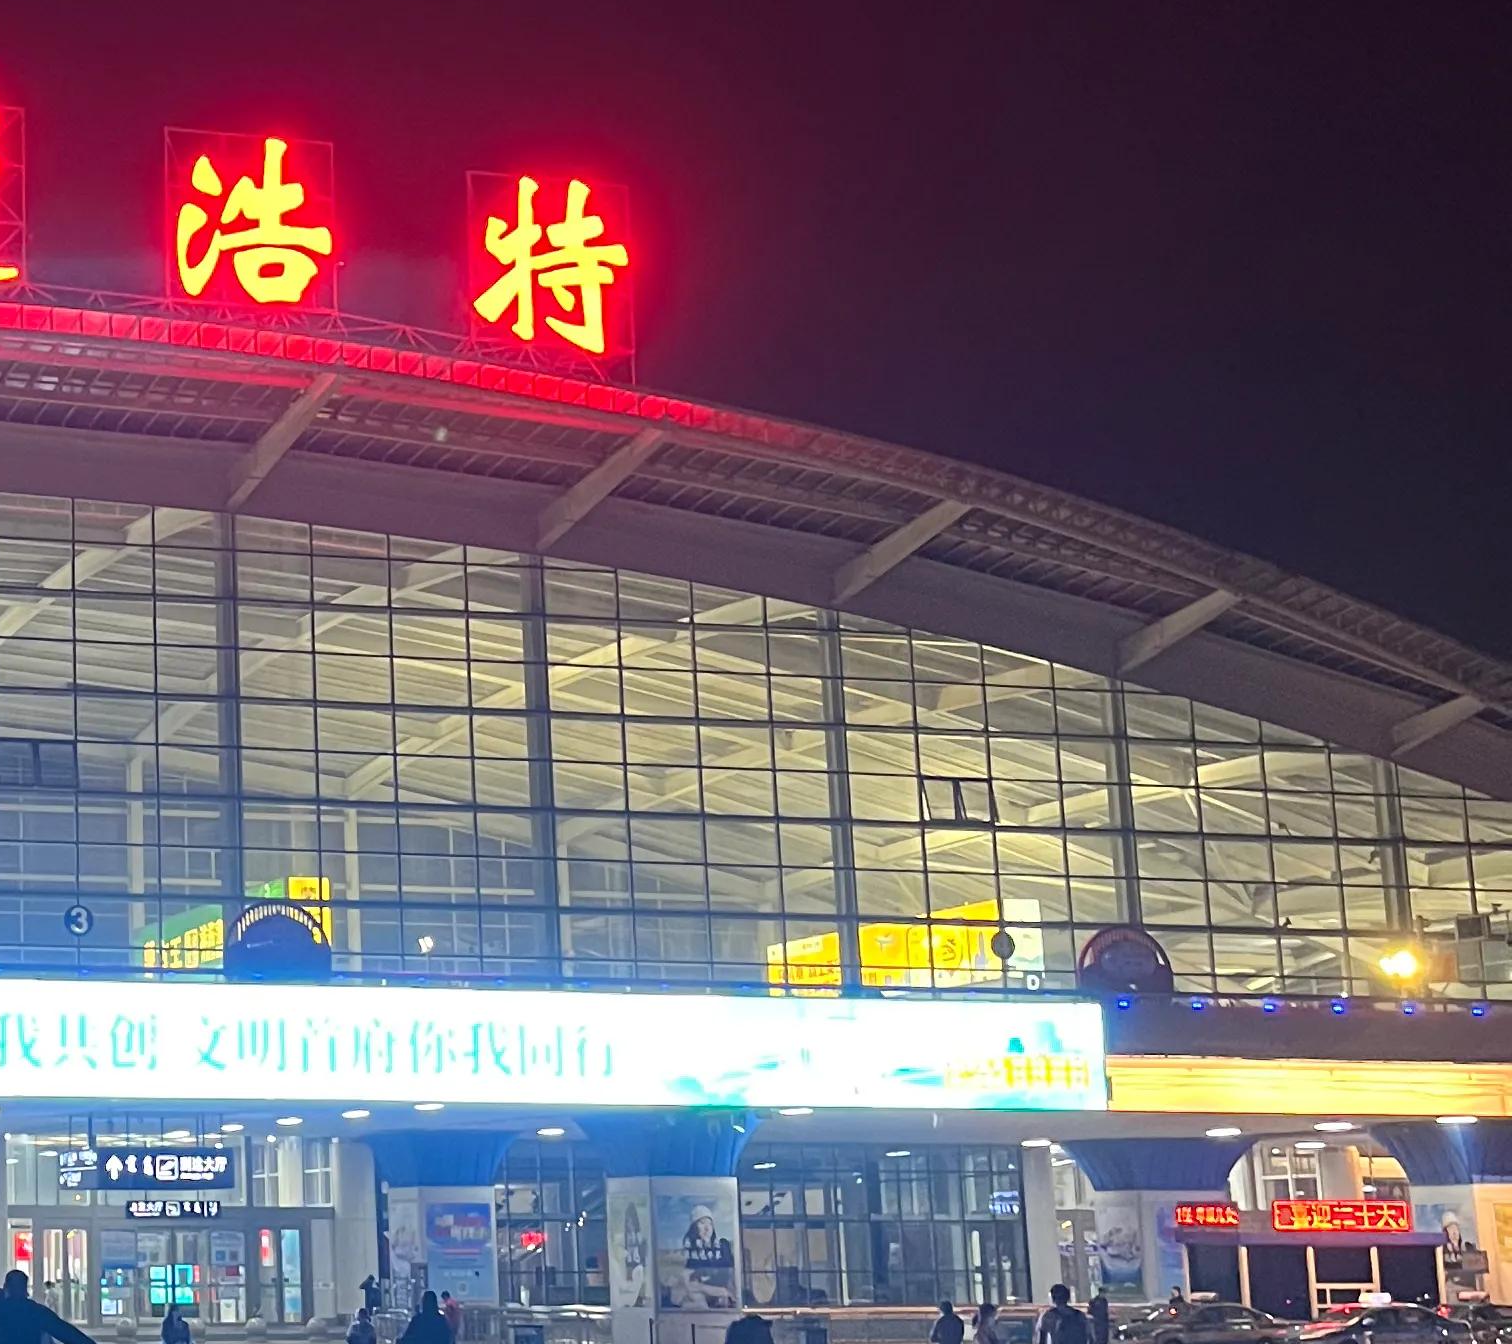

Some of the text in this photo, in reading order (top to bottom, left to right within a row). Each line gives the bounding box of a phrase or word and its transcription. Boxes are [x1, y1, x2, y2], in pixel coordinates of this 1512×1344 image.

[71, 907, 88, 933] 3
[197, 1016, 615, 1078] 文明首府你我同行
